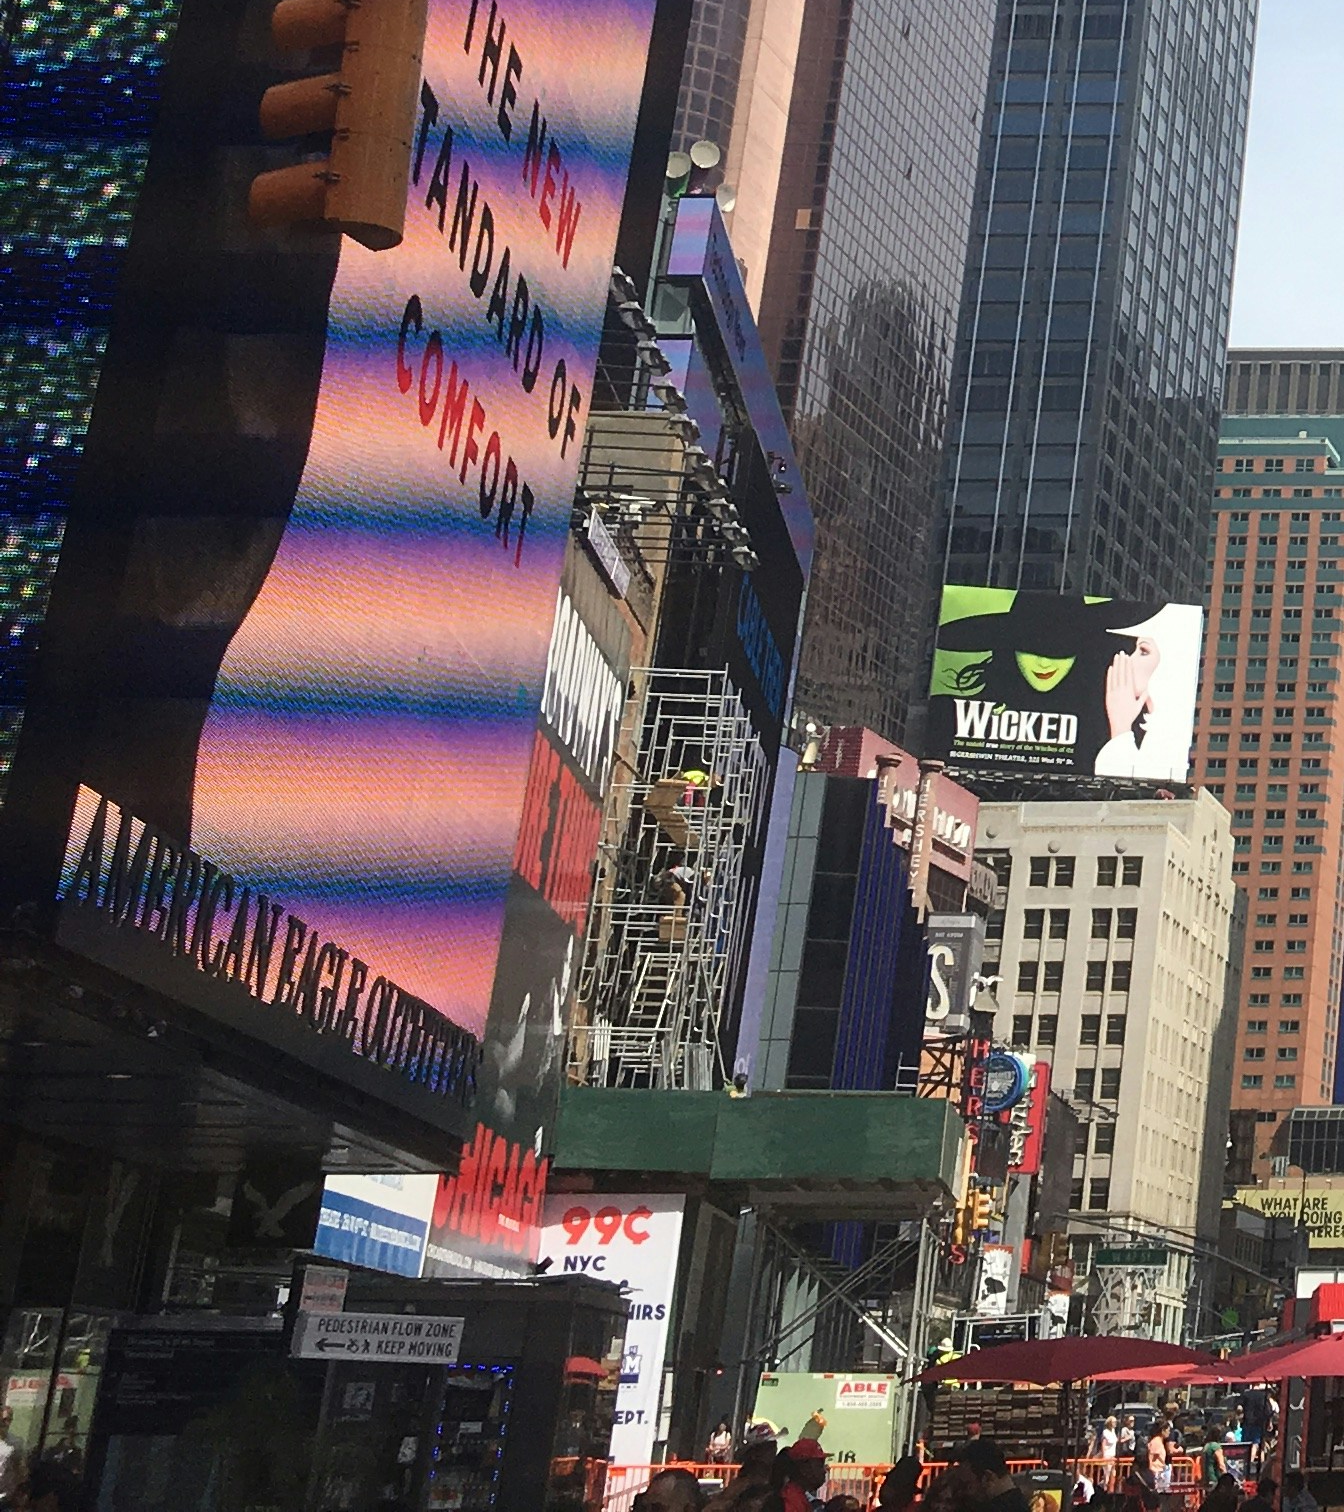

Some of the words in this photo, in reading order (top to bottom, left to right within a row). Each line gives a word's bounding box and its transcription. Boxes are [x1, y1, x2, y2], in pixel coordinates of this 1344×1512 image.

[521, 98, 582, 271] NEW
[412, 81, 544, 394] TANDARD
[548, 358, 582, 460] OF
[398, 294, 535, 569] COMFORT
[62, 788, 285, 1006] AMERICAN
[278, 914, 370, 1053] EAGLE
[1261, 1198, 1299, 1211] WHAT
[1305, 1197, 1328, 1210] ARE
[562, 1205, 653, 1245] 99¢
[1303, 1211, 1343, 1225] DOING
[563, 1255, 607, 1272] NYC
[318, 1318, 390, 1335] PEDESTRIAN
[391, 1321, 423, 1336] FLOW
[425, 1323, 457, 1338] ZONE
[376, 1340, 405, 1355] KEEP
[408, 1341, 453, 1357] MOVING
[840, 1383, 888, 1395] ABLE
[613, 1410, 649, 1424] EPT.
